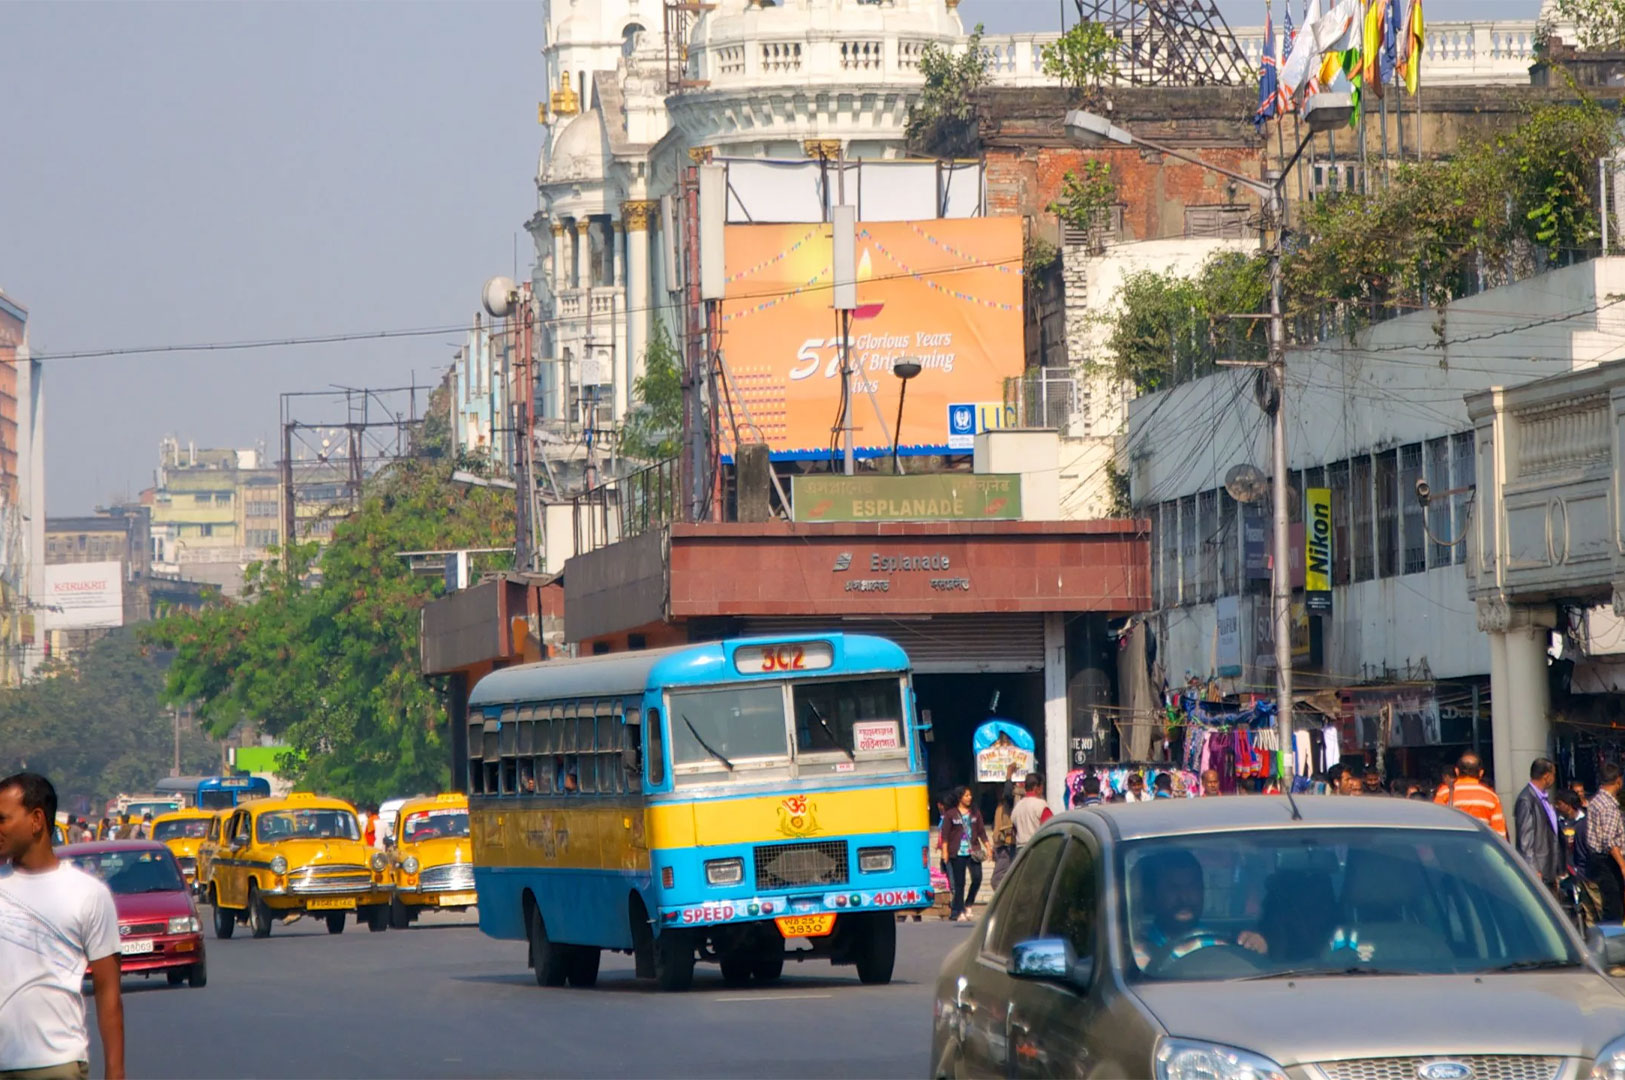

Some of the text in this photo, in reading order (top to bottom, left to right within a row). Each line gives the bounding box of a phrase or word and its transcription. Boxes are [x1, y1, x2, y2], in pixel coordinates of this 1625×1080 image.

[857, 331, 952, 350] Glorious Years
[869, 350, 954, 374] Brigning
[850, 378, 879, 394] ives
[852, 499, 964, 517] ESPLANADE
[1309, 503, 1329, 576] Nikon
[870, 552, 950, 575] Esplanade
[683, 905, 733, 924] SPEED
[788, 924, 823, 934] 3830
